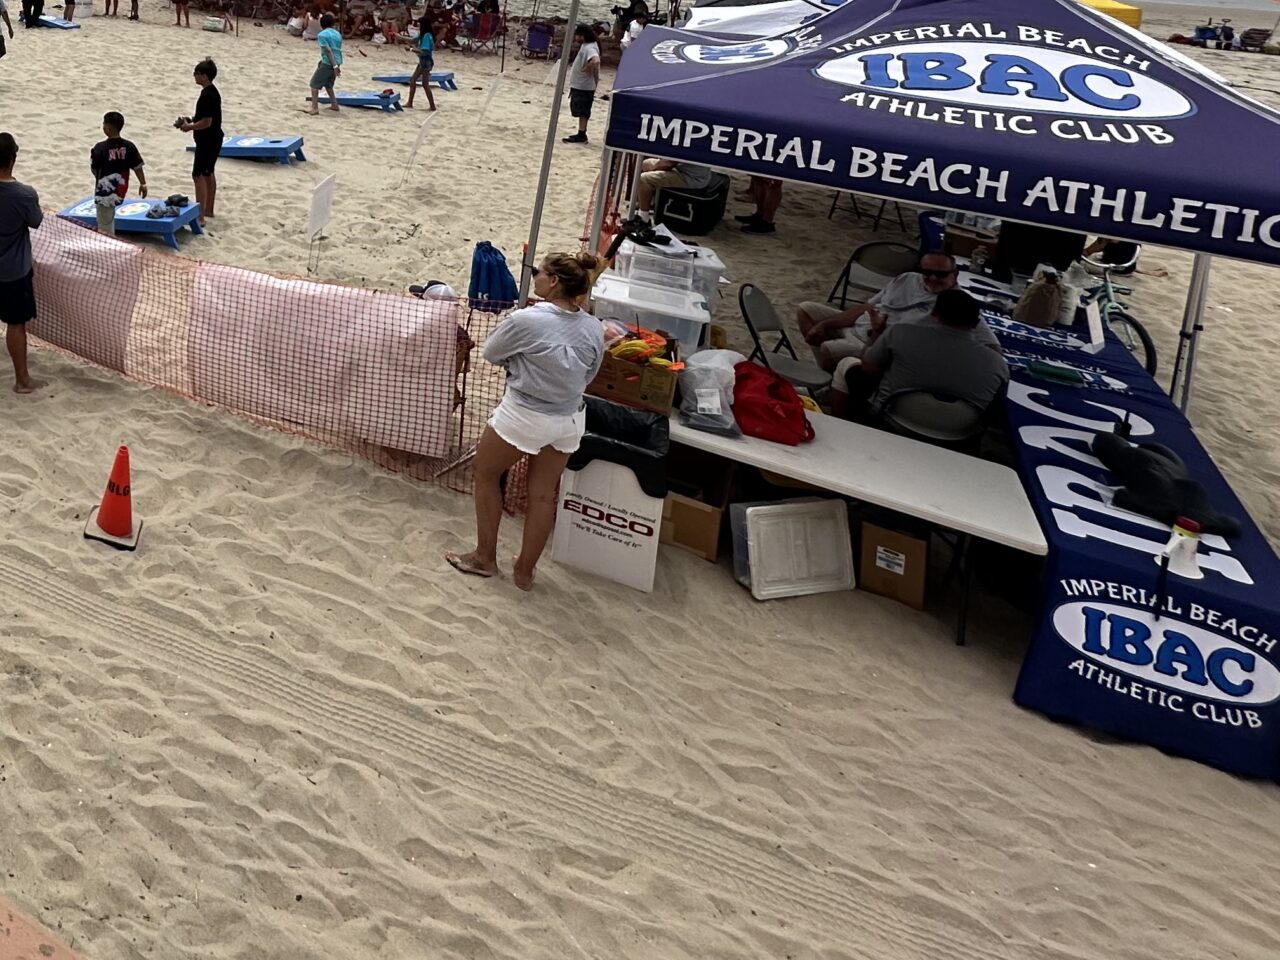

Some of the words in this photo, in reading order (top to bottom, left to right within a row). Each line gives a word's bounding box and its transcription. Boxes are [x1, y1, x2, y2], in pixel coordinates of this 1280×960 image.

[828, 22, 1006, 53] IMPERIAL
[1016, 25, 1152, 71] BEACH
[857, 51, 1142, 111] IBAC
[839, 91, 1038, 135] ATHLETIC
[1049, 118, 1175, 144] CLUB
[636, 112, 835, 173] IMPERIAL
[849, 145, 1009, 203] BEACH
[1021, 176, 1280, 249] ATHLETIC
[563, 499, 654, 537] EDCO
[592, 527, 606, 538] Take
[607, 534, 623, 543] Care
[607, 504, 629, 516] Locally
[629, 511, 657, 524] Operated
[1081, 606, 1256, 697] IBAC
[1189, 603, 1277, 653] BEACH
[1068, 658, 1185, 713] ATHLETIC
[1191, 702, 1263, 729] CLUB
